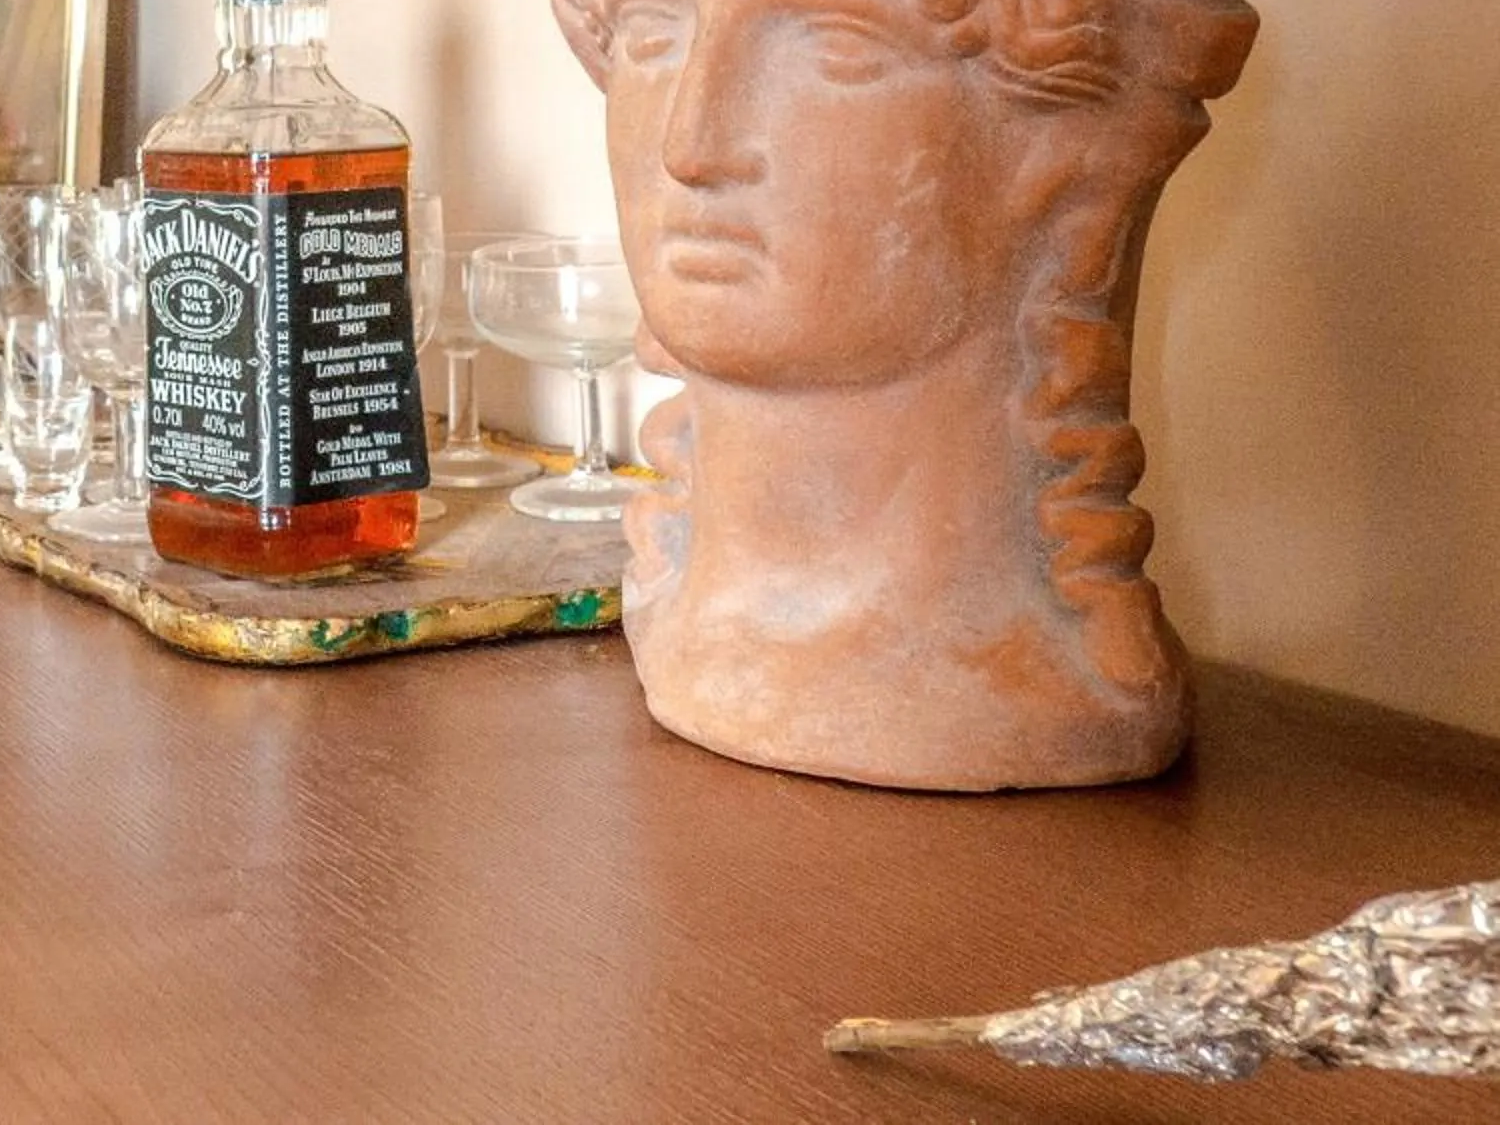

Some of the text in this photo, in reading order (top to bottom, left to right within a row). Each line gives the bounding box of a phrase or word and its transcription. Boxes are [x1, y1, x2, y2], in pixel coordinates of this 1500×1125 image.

[137, 208, 265, 284] JACK DANIEL'S
[299, 229, 341, 260] GOLD
[171, 256, 192, 270] OLD
[181, 282, 209, 299] Old
[338, 321, 367, 337] 1905
[155, 335, 242, 380] Tennessee
[275, 215, 292, 488] BOTTLED AT THE DISTILLERY
[358, 356, 388, 373] 1914
[151, 378, 247, 415] WHISKEY
[363, 396, 399, 414] 1954
[378, 459, 412, 476] 1981
